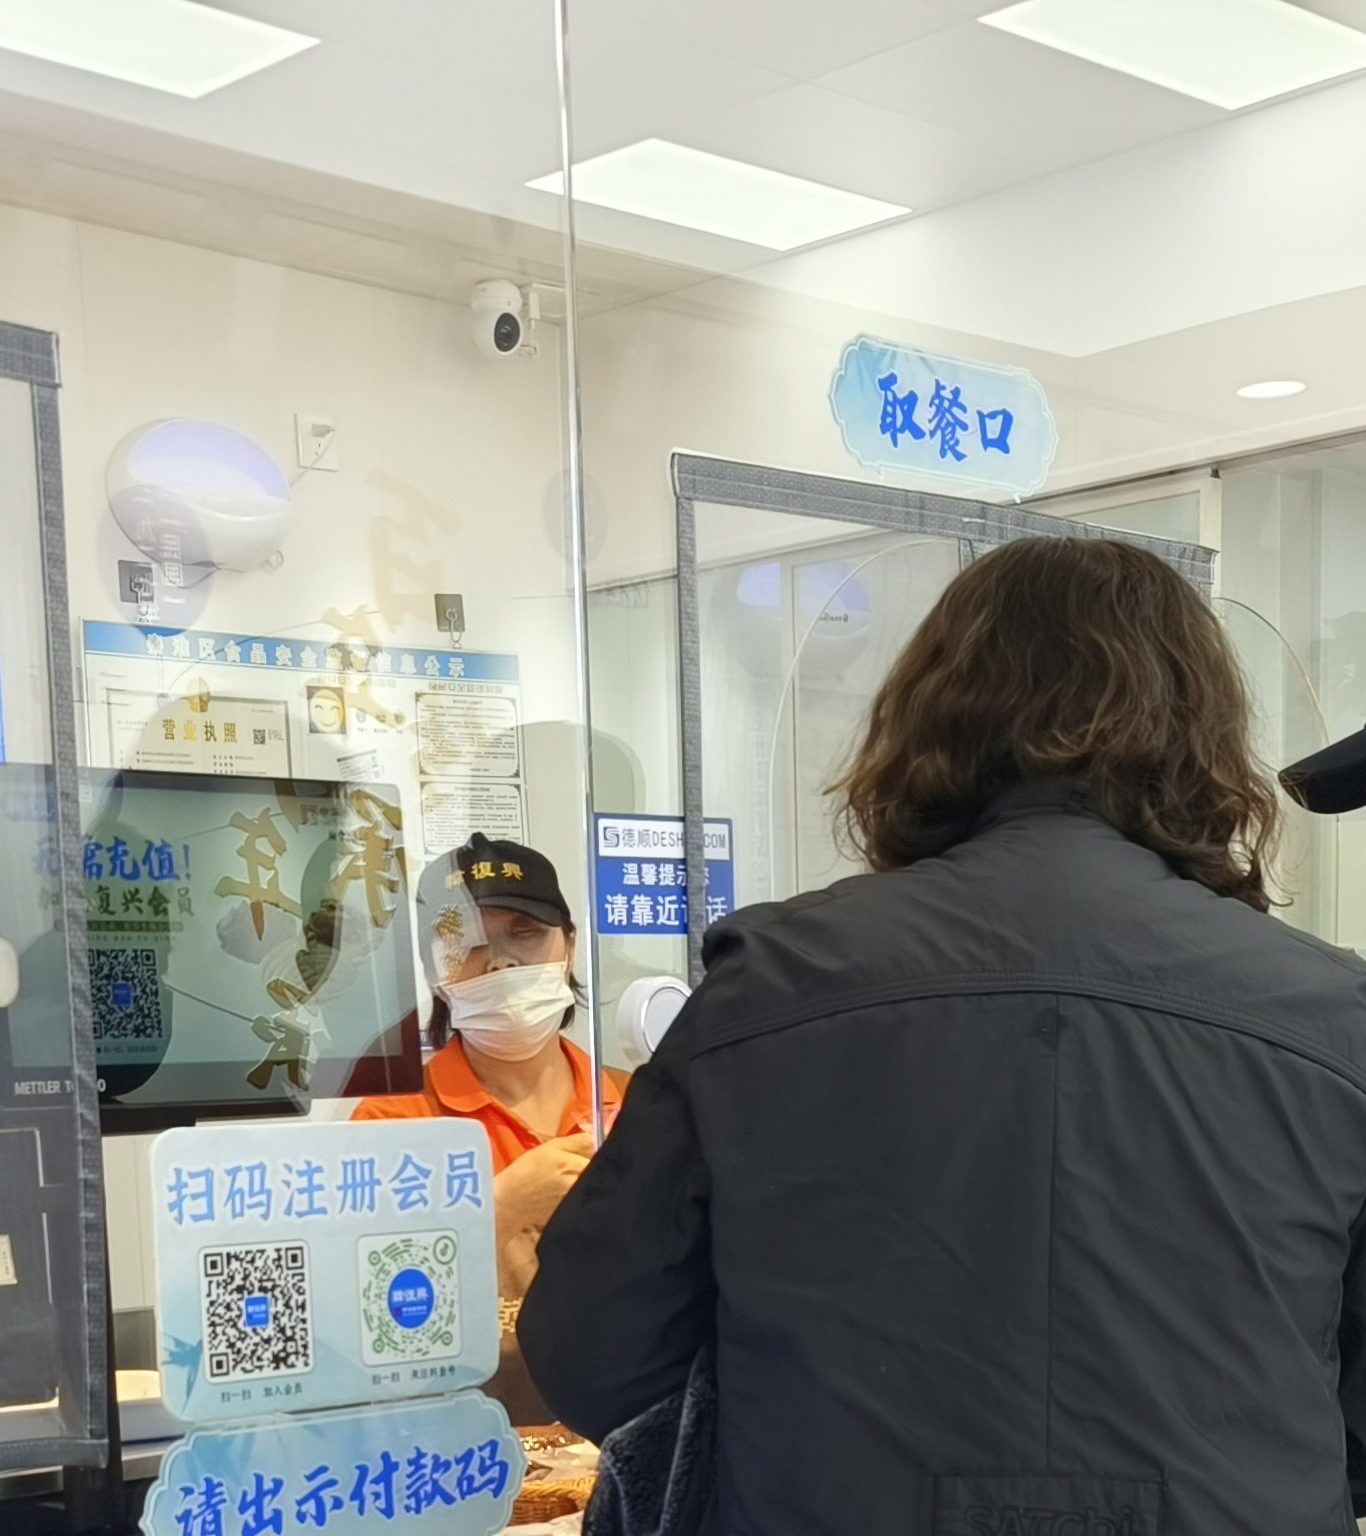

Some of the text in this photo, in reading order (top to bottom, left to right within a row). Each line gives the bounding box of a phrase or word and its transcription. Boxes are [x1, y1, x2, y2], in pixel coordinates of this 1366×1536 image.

[877, 374, 1015, 461] 取餐口
[161, 719, 238, 745] 营业执照
[622, 828, 727, 850] 德顺DESHCOM
[623, 863, 709, 886] 温馨提示
[604, 894, 728, 927] 请靠近话
[14, 1080, 62, 1095] METTLER
[167, 1150, 483, 1226] 扫码注册会员
[372, 1371, 400, 1385] 扫一扫
[221, 1388, 252, 1403] 扫一扫
